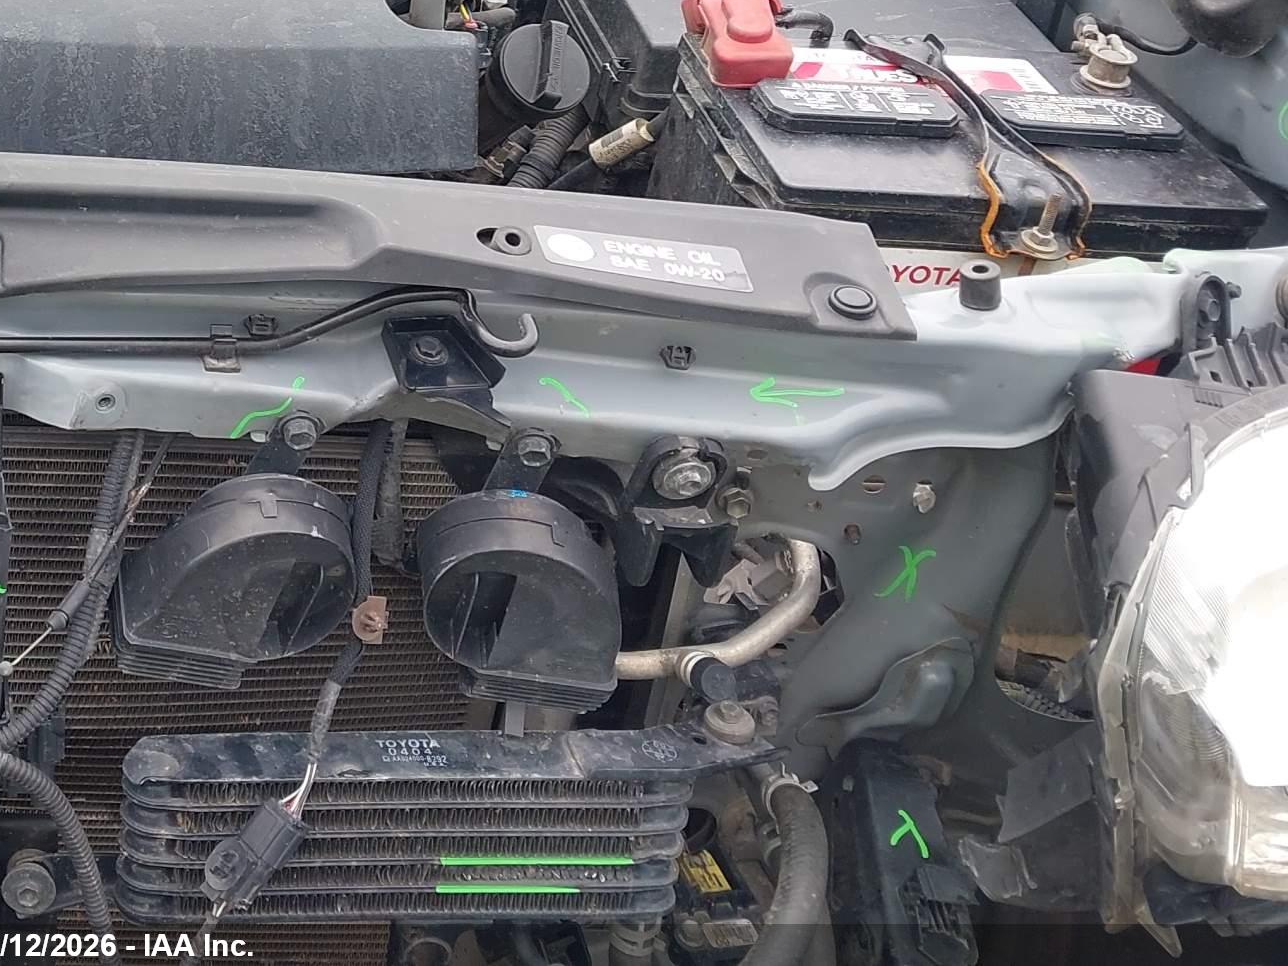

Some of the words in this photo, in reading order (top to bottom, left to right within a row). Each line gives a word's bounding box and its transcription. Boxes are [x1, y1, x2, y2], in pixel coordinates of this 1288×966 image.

[602, 239, 677, 261] ENGINE
[686, 249, 722, 267] OIL
[610, 257, 652, 272] SAE
[663, 262, 726, 283] 0W-20
[890, 263, 961, 286] YOTA
[375, 739, 441, 748] TOYOTA
